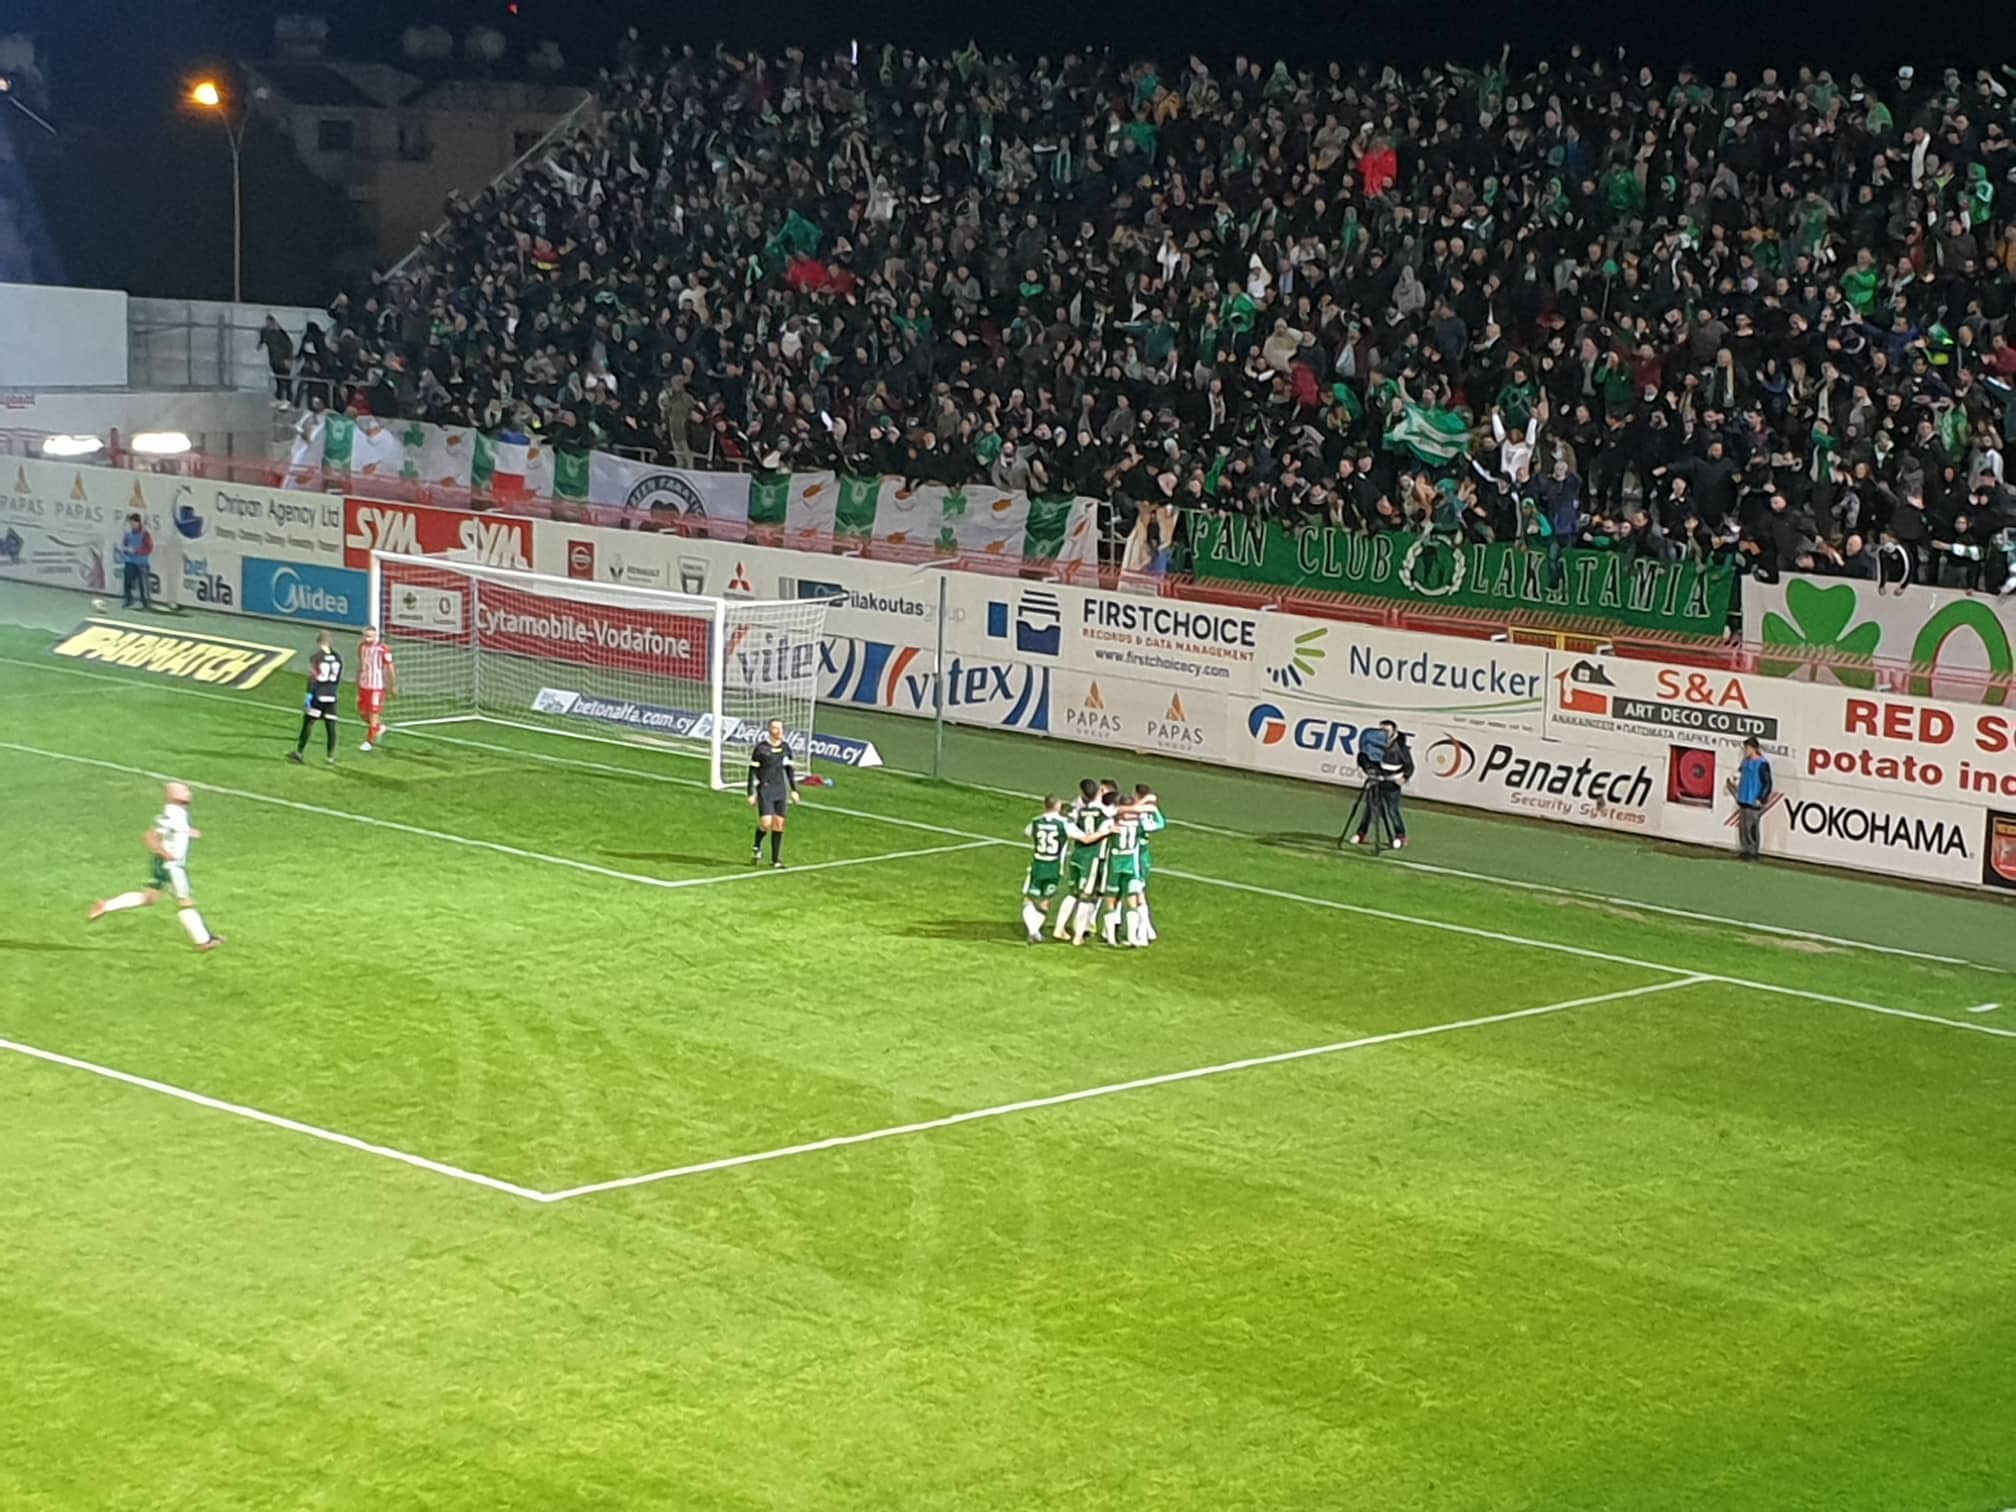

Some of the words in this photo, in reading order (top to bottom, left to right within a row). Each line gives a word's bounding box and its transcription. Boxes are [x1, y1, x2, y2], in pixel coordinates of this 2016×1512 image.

[56, 501, 104, 523] PAPAS
[269, 499, 316, 528] Agency
[321, 503, 340, 528] Ltd
[346, 506, 424, 557] SYM
[447, 518, 533, 570] SYM
[1191, 509, 1267, 567] FAN
[1297, 524, 1394, 583] CLUB
[196, 574, 233, 606] alfa
[286, 579, 348, 615] Midea
[475, 603, 692, 660] Cytamobile-Vodafone
[1083, 598, 1257, 648] FIRSTCHOICE
[737, 631, 839, 683] vitex
[1082, 628, 1133, 645] RECORDS
[1145, 637, 1172, 650] DATA
[1175, 641, 1255, 662] MANAGEMENT
[1095, 648, 1231, 679] www.firstchoicecy.com
[1350, 644, 1540, 699] Nordzucker
[1656, 668, 1749, 710] S&A
[573, 700, 696, 735] betonalfa.com.cy
[1066, 708, 1121, 732] PAPAS
[1147, 721, 1203, 745] PAPAS
[1623, 702, 1655, 719] ART
[1660, 708, 1703, 727] DECO
[1707, 714, 1730, 731] CO
[1736, 717, 1766, 735] LTD
[1844, 698, 1955, 745] RED
[1975, 715, 2016, 752] S
[1478, 743, 1653, 808] Panatech
[1807, 747, 1944, 786] potato
[1510, 792, 1573, 815] Security
[1579, 802, 1647, 825] Systems
[1036, 830, 1059, 854] 35
[1783, 798, 1969, 859] YOKOHAMA
